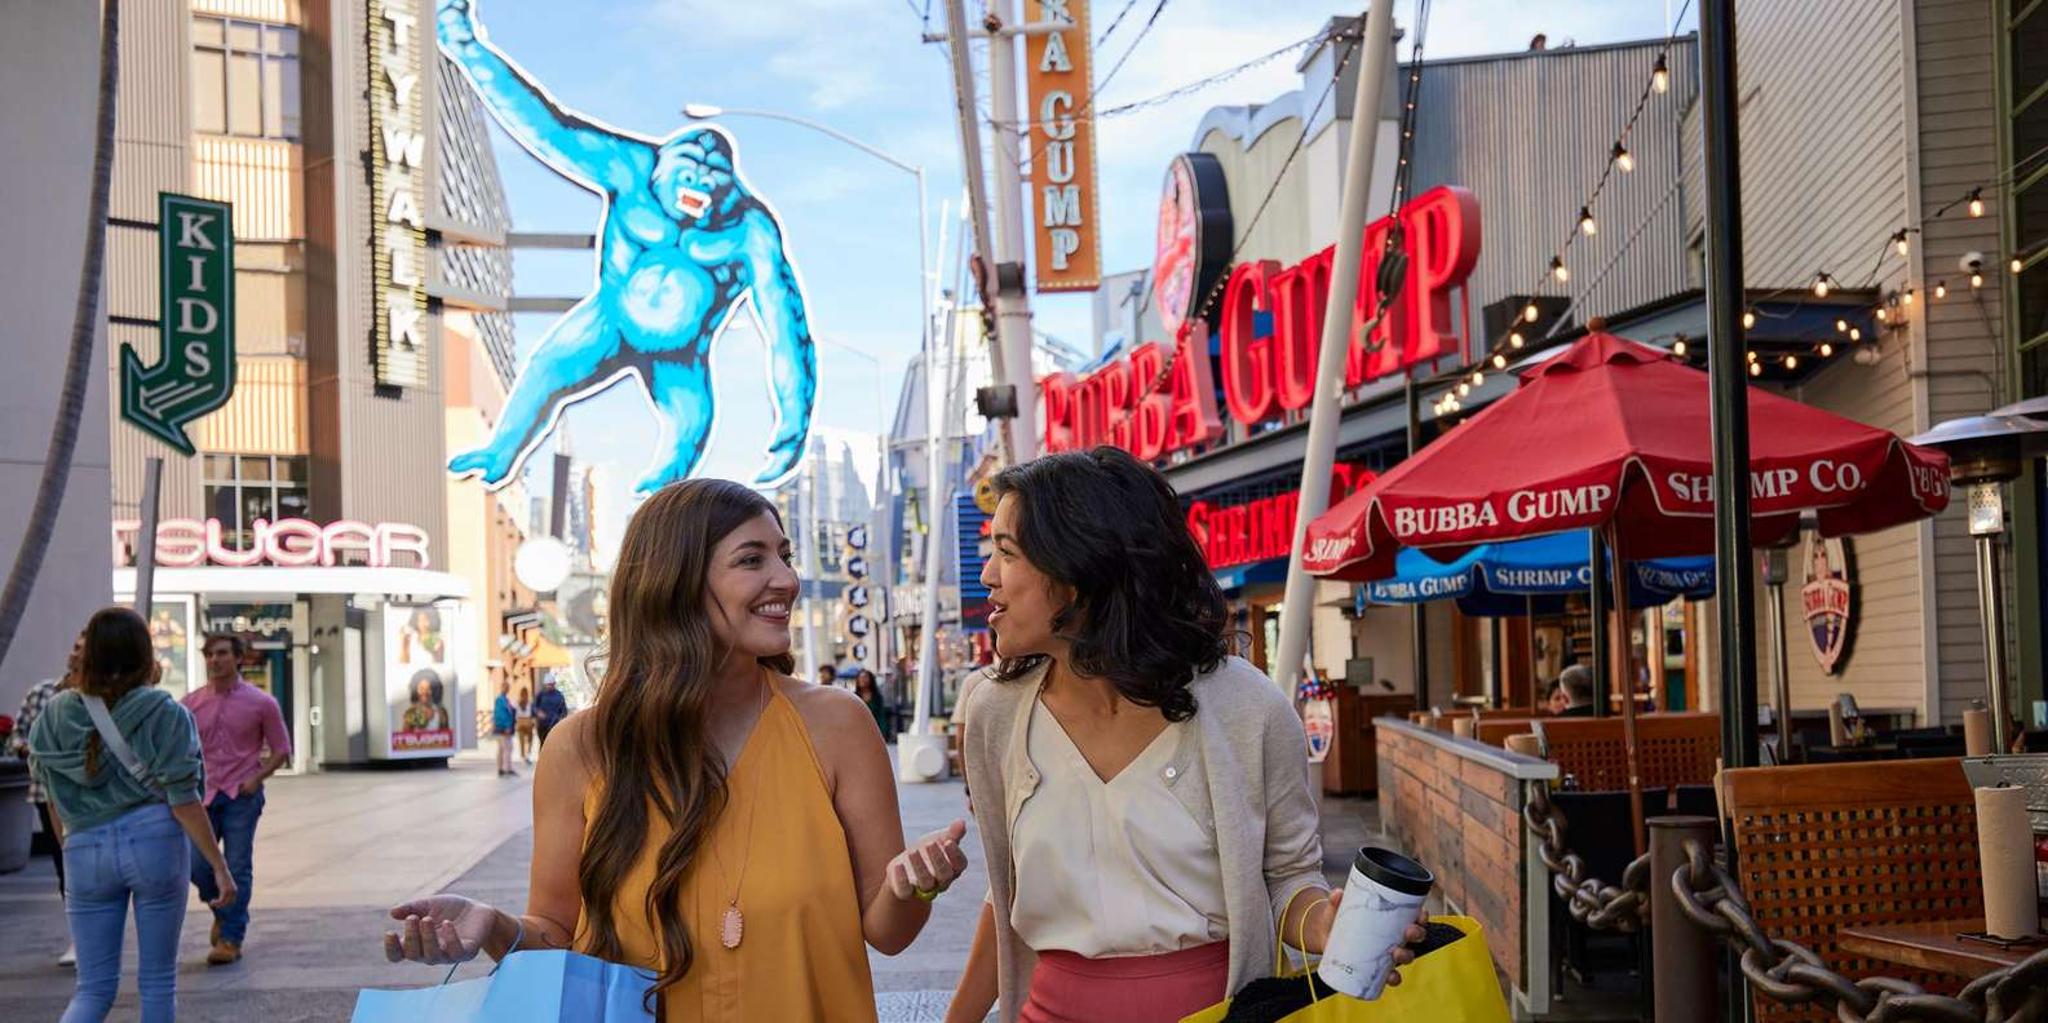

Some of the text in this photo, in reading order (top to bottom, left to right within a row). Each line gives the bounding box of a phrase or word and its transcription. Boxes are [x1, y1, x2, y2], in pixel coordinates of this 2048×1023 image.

[383, 9, 424, 347] TYWALK
[1040, 89, 1083, 271] GUMP
[176, 212, 218, 377] KIDS
[1043, 314, 1220, 462] BUBBA
[1395, 501, 1499, 537] BUBBA
[1508, 484, 1612, 522] GUMP
[1668, 468, 1798, 503] SHMP
[1188, 489, 1299, 569] SHRIM
[1420, 575, 1467, 597] GUMP
[1496, 567, 1571, 586] SHRIMP
